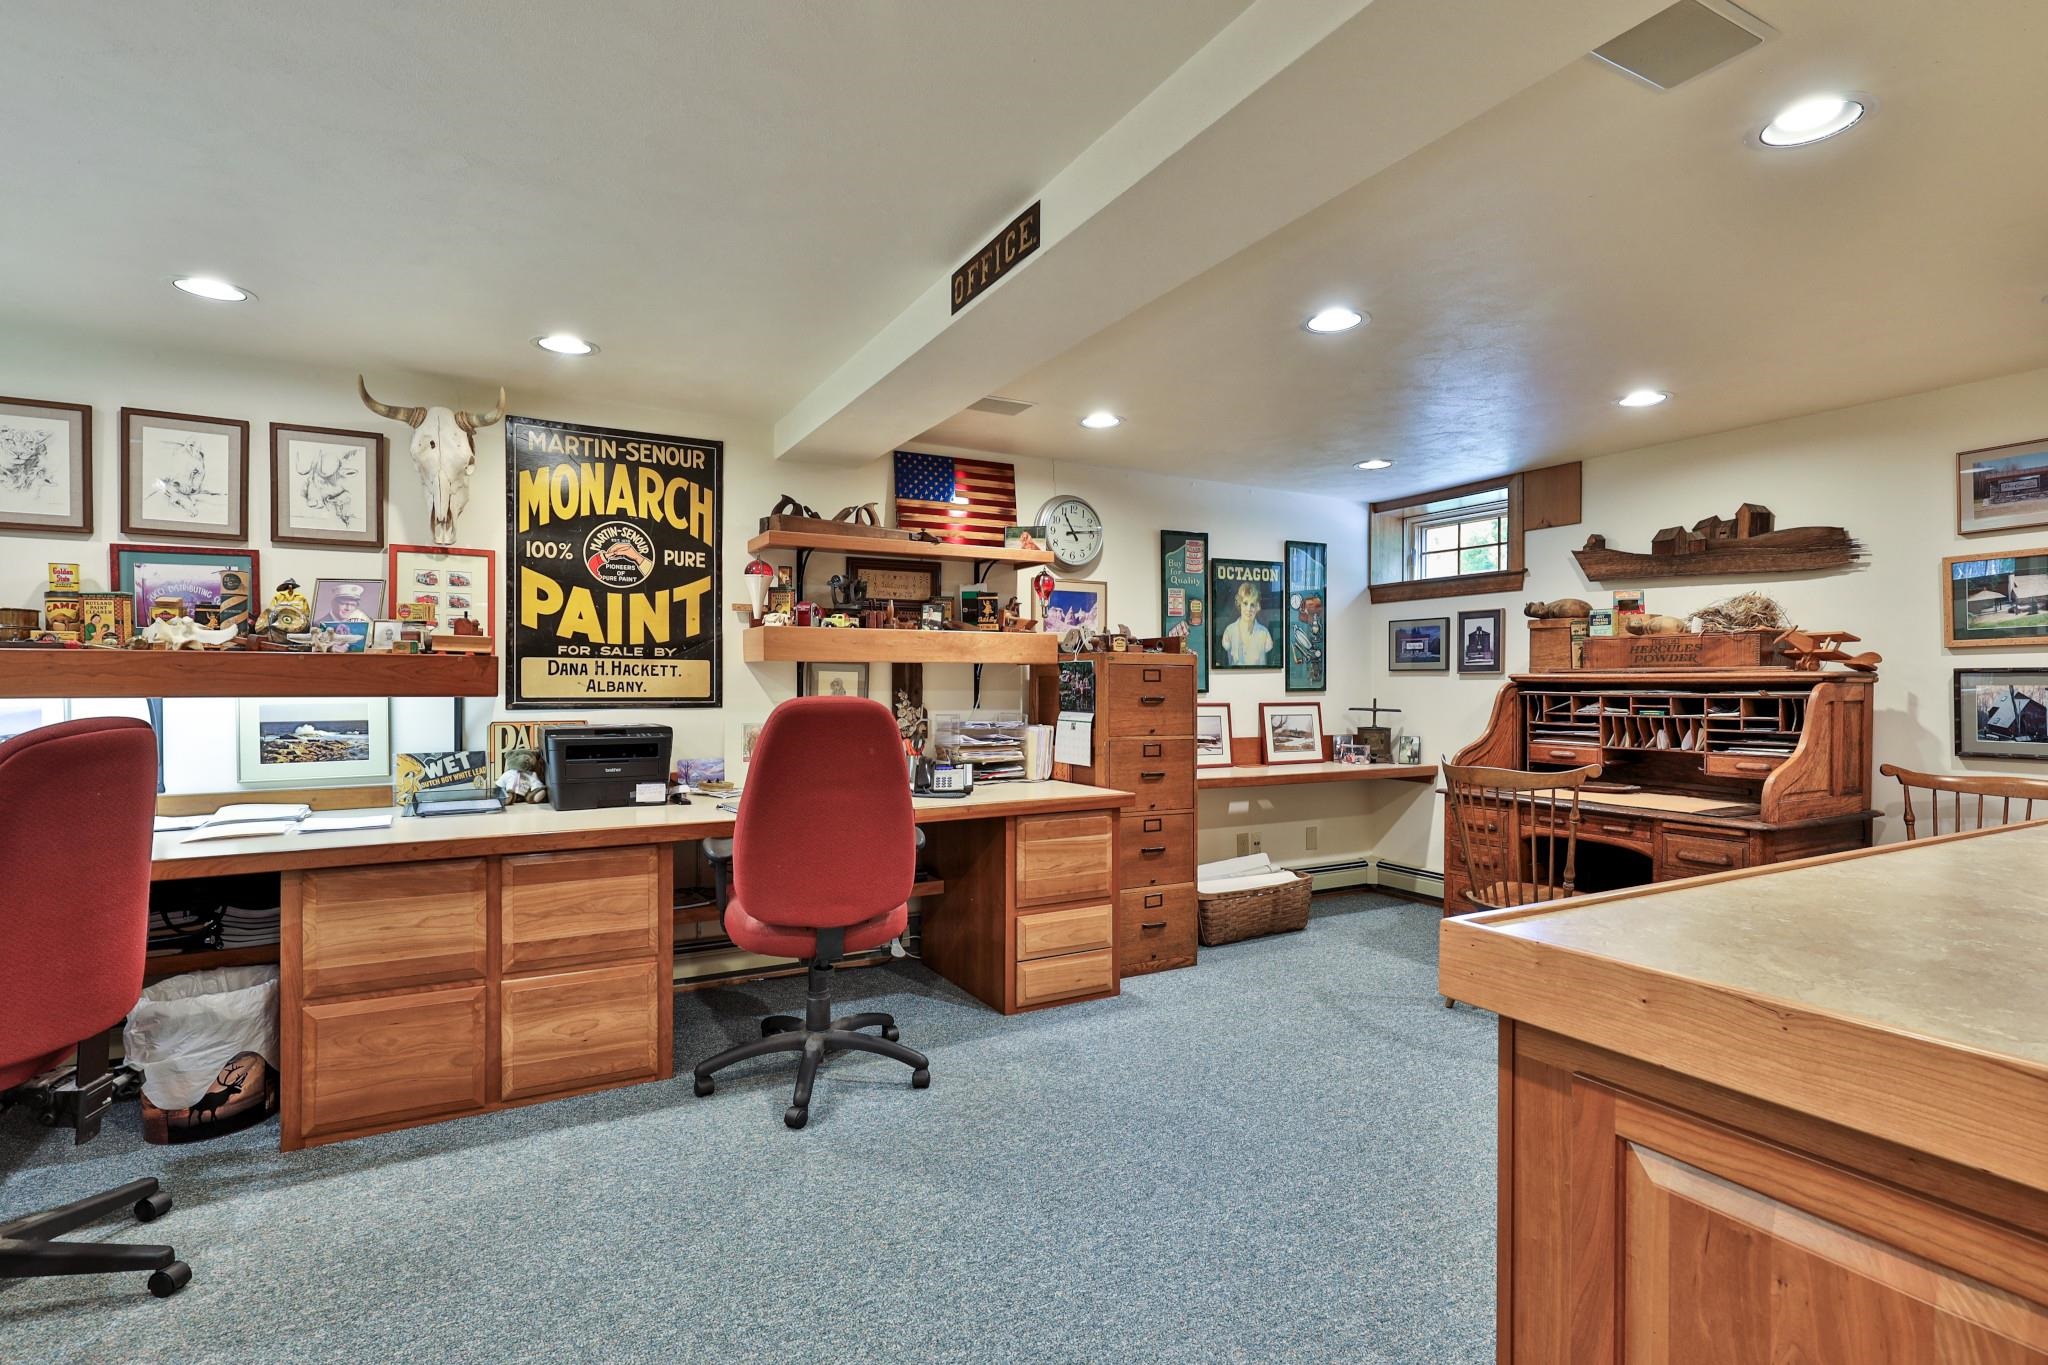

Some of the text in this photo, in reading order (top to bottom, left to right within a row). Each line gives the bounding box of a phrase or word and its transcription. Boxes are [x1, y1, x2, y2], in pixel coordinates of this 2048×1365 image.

[528, 430, 705, 470] MARTIN-SENOUR
[519, 462, 712, 547] MONARCH
[1070, 505, 1078, 514] 12
[1053, 516, 1060, 524] 10
[1050, 526, 1056, 535] 9
[590, 526, 649, 554] MARTIN-SENOUR
[526, 540, 574, 560] 100%
[1069, 551, 1076, 560] 6
[664, 549, 706, 568] PURE
[1168, 558, 1182, 568] Buy
[1170, 575, 1201, 586] Quality
[1217, 565, 1279, 582] OCTAGON
[46, 602, 79, 613] CAME
[521, 565, 711, 645] PAINT
[558, 645, 678, 657] FOR SALE BY
[1630, 643, 1703, 654] HERCULES
[1634, 653, 1698, 663] POWDER
[547, 659, 588, 676] DANA
[586, 679, 647, 693] ALBANY.
[425, 751, 471, 779] WET
[440, 775, 453, 784] BOY
[453, 770, 472, 780] WHITE
[472, 766, 487, 776] LEAD
